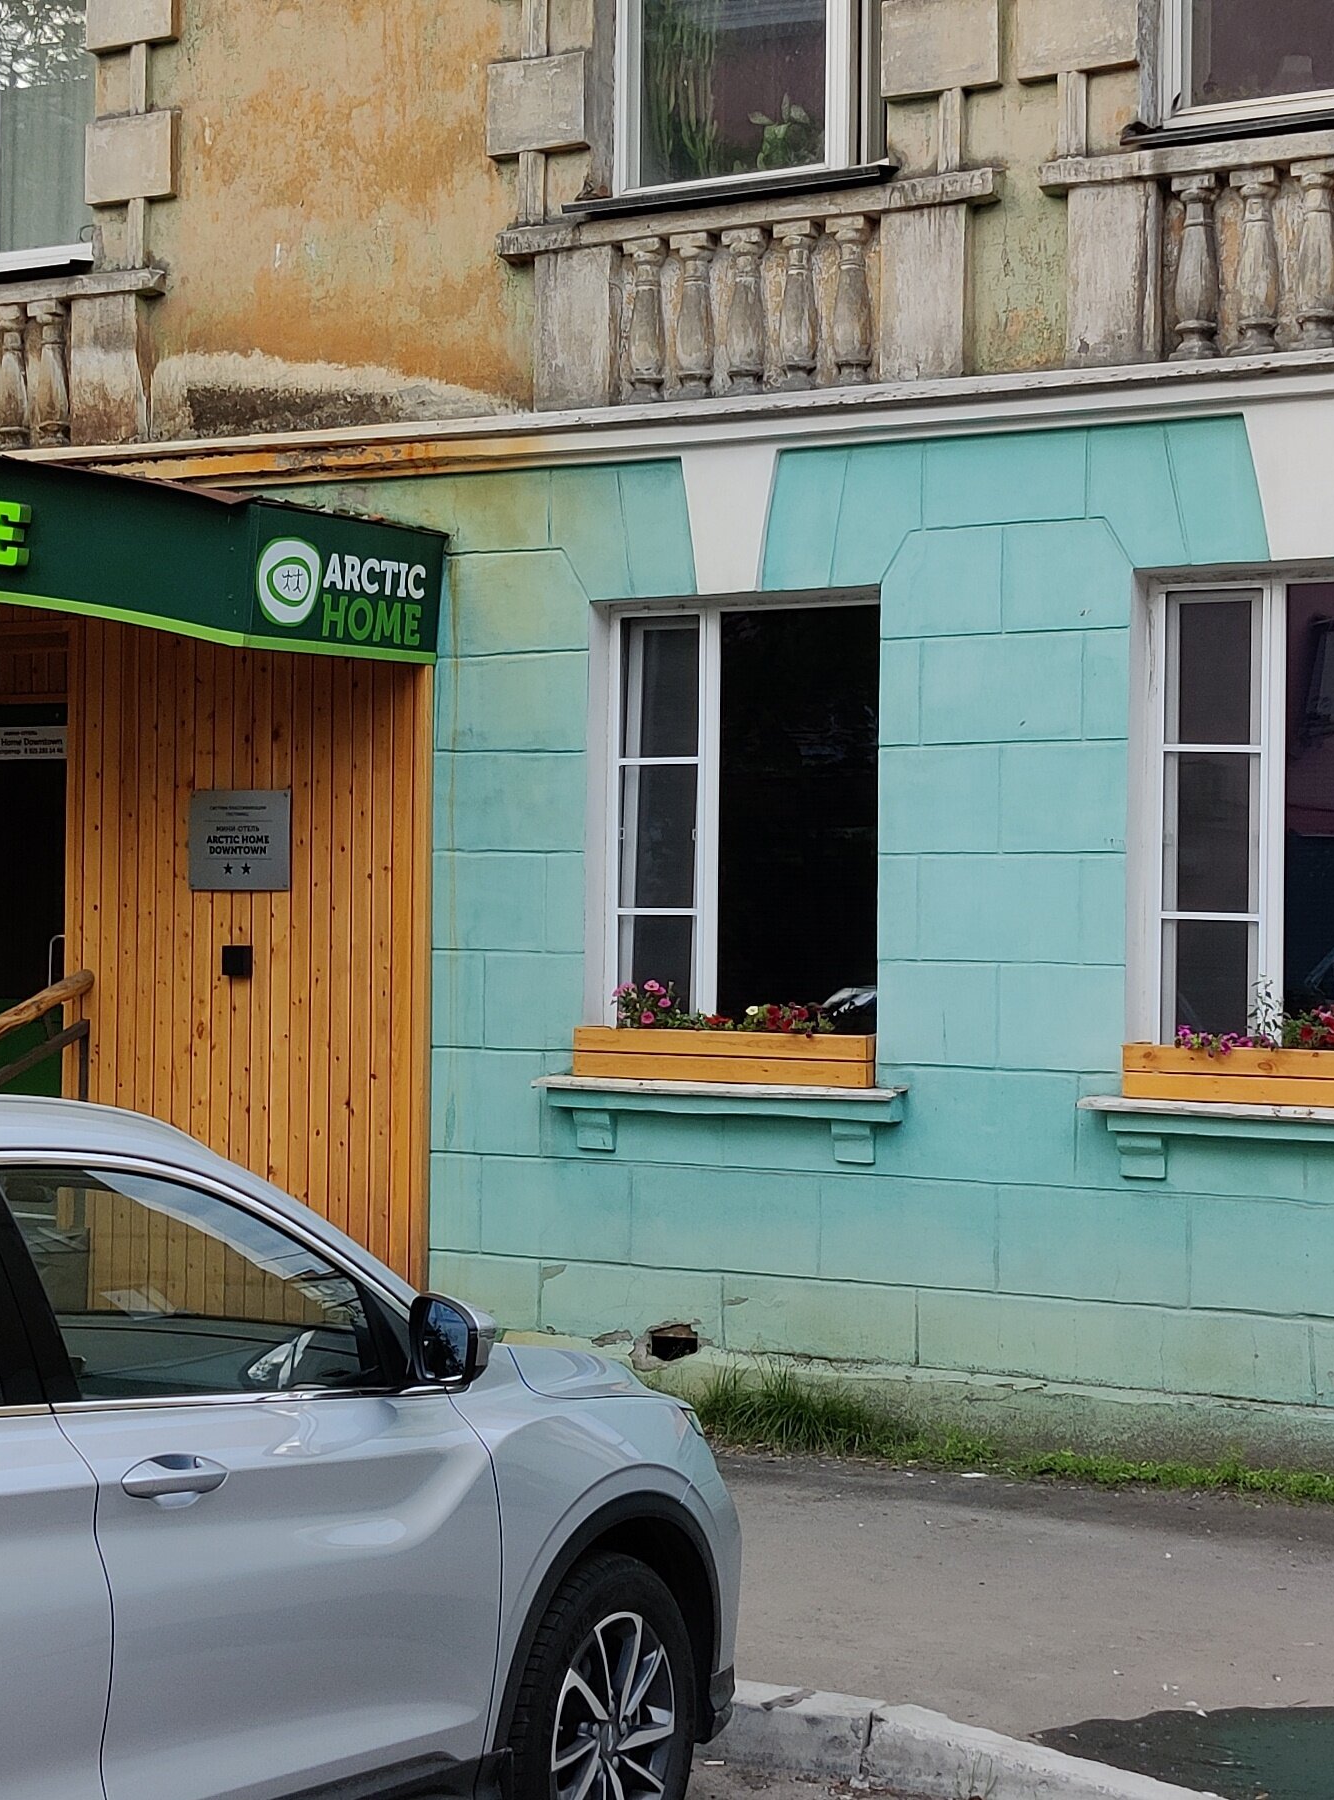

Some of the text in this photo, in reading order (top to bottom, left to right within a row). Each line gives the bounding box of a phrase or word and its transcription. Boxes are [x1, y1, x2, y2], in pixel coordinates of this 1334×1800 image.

[323, 553, 426, 600] ARCTIC
[321, 593, 422, 646] HOME
[207, 835, 270, 844] ARCTIC HOME
[209, 846, 267, 855] DOWNTOWN
